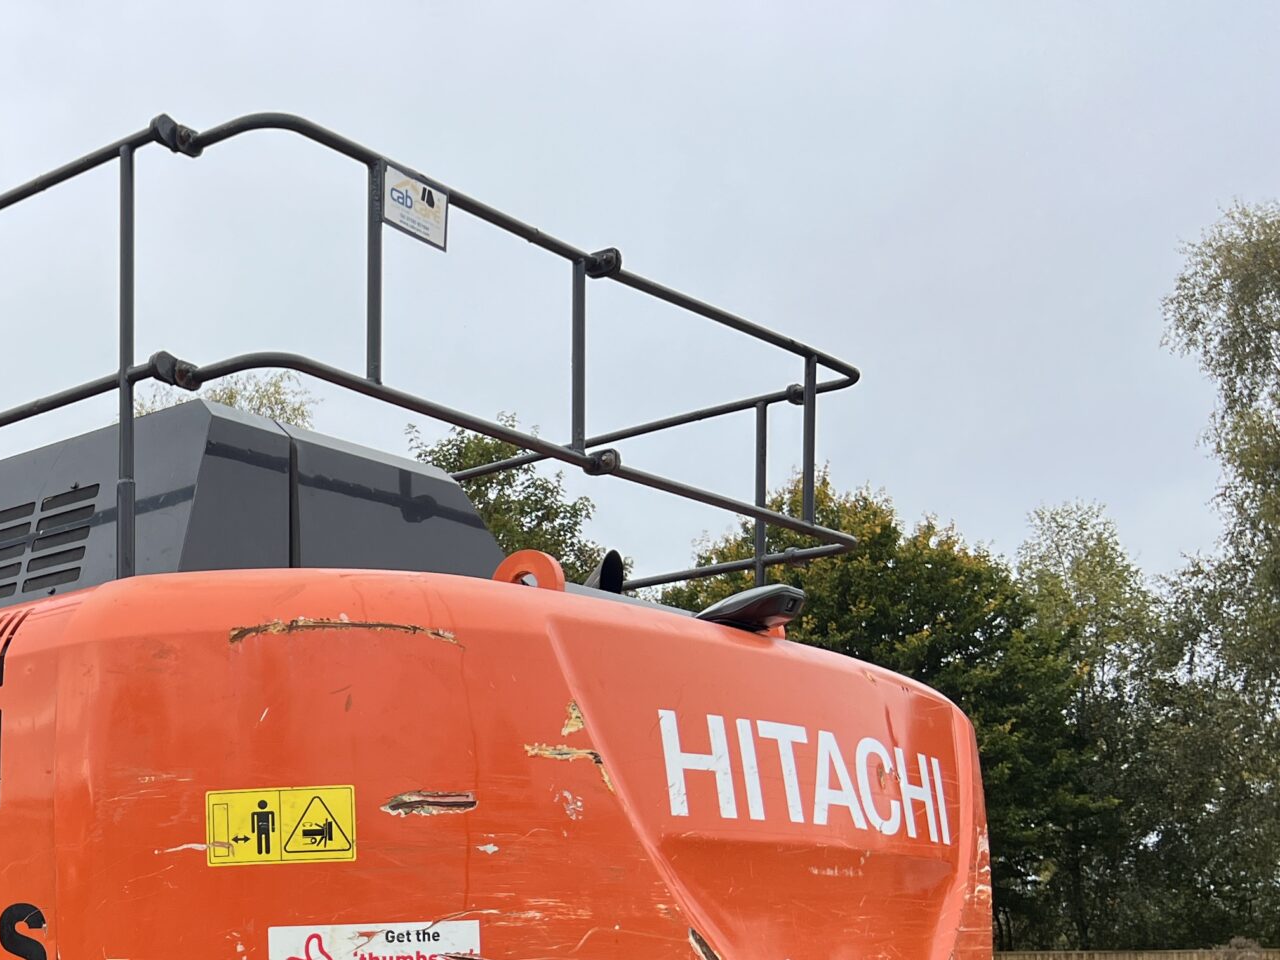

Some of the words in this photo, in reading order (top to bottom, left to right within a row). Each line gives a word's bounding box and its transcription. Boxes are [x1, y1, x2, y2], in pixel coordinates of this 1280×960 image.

[390, 187, 413, 209] cab
[658, 709, 951, 846] HITACHI
[385, 930, 412, 943] Get
[416, 929, 441, 942] the
